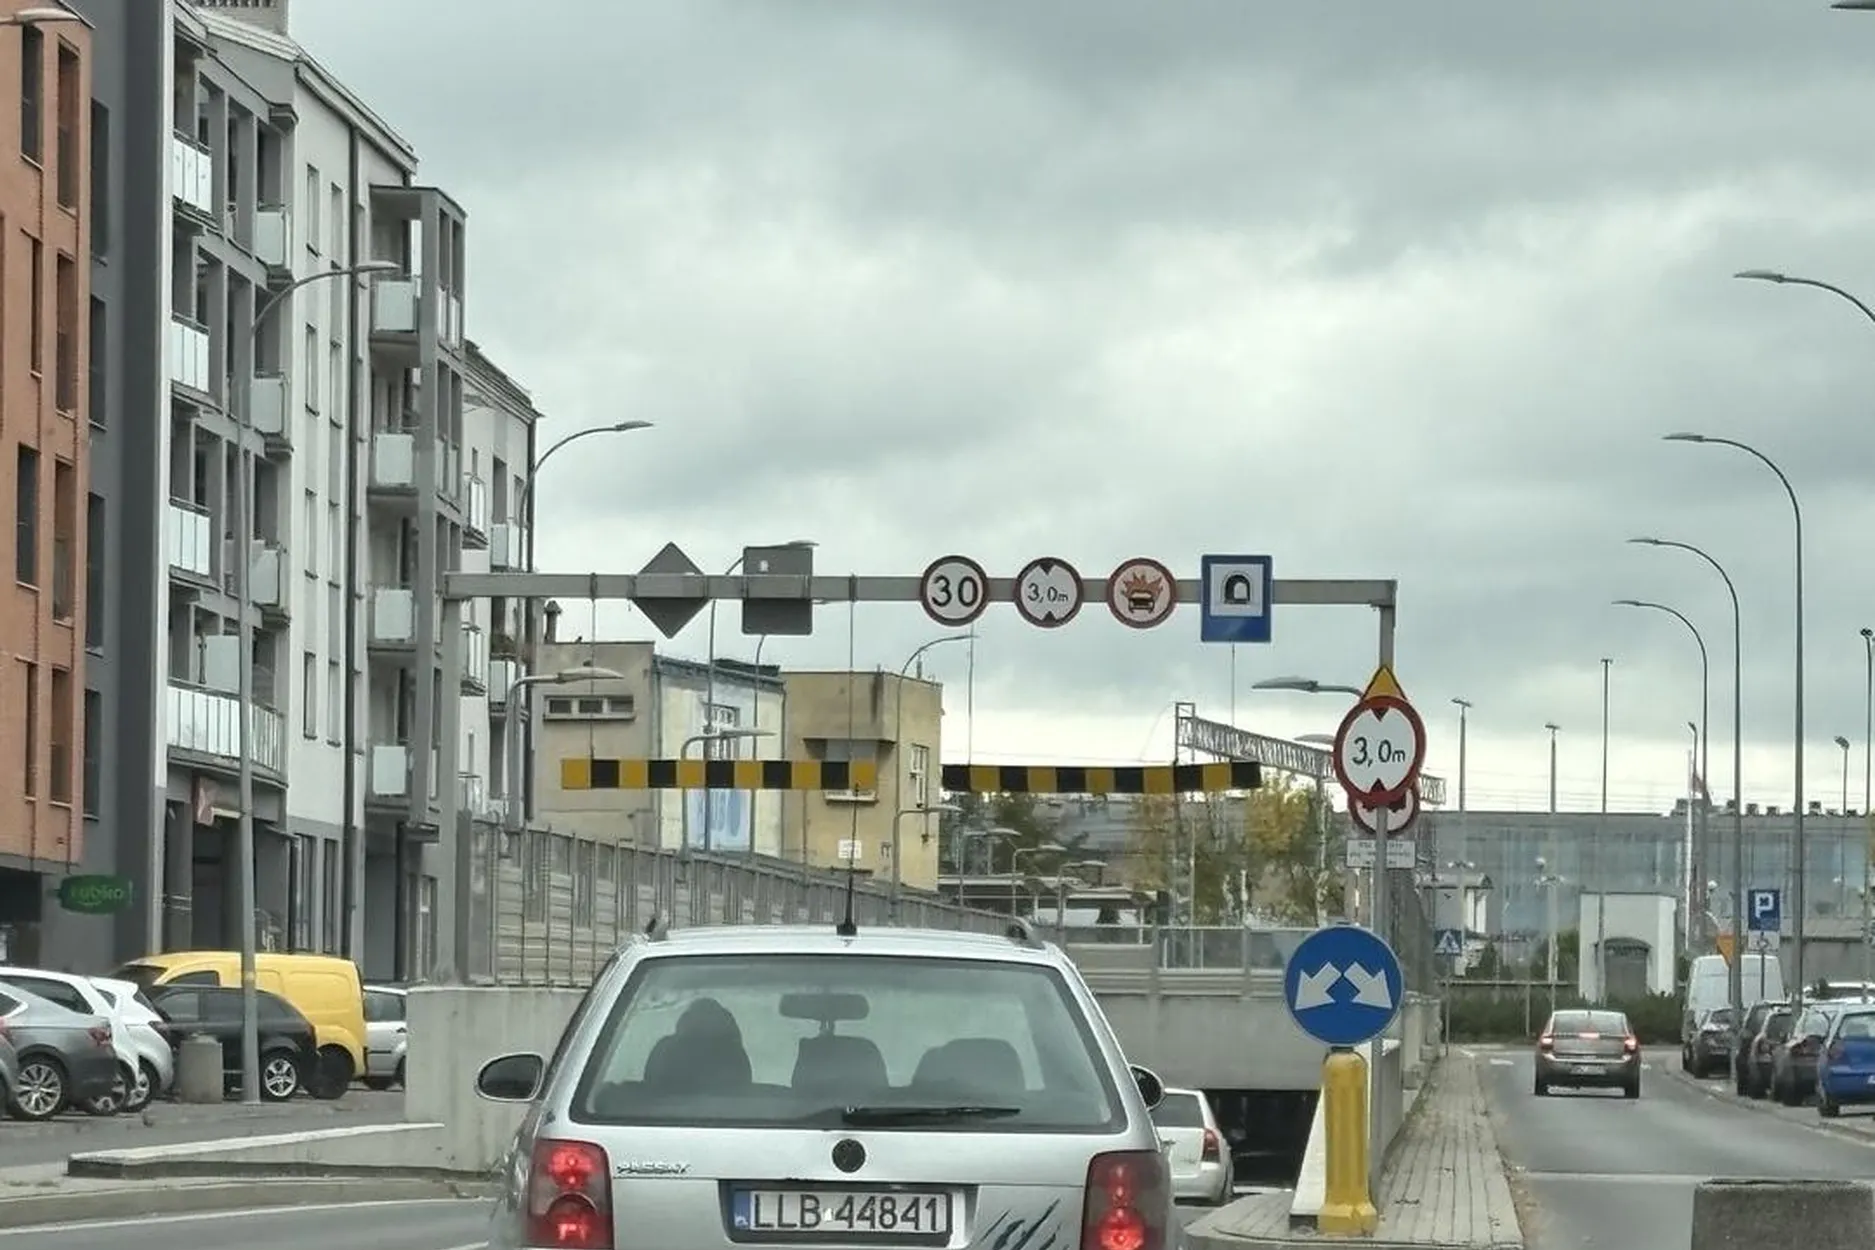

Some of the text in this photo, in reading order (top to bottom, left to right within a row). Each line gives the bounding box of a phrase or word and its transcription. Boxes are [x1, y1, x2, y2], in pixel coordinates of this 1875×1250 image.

[931, 574, 979, 607] 30
[1027, 582, 1069, 604] 3,0m
[1352, 736, 1406, 769] 3,0m
[1754, 892, 1775, 919] P
[754, 1193, 938, 1232] LLB 44841
